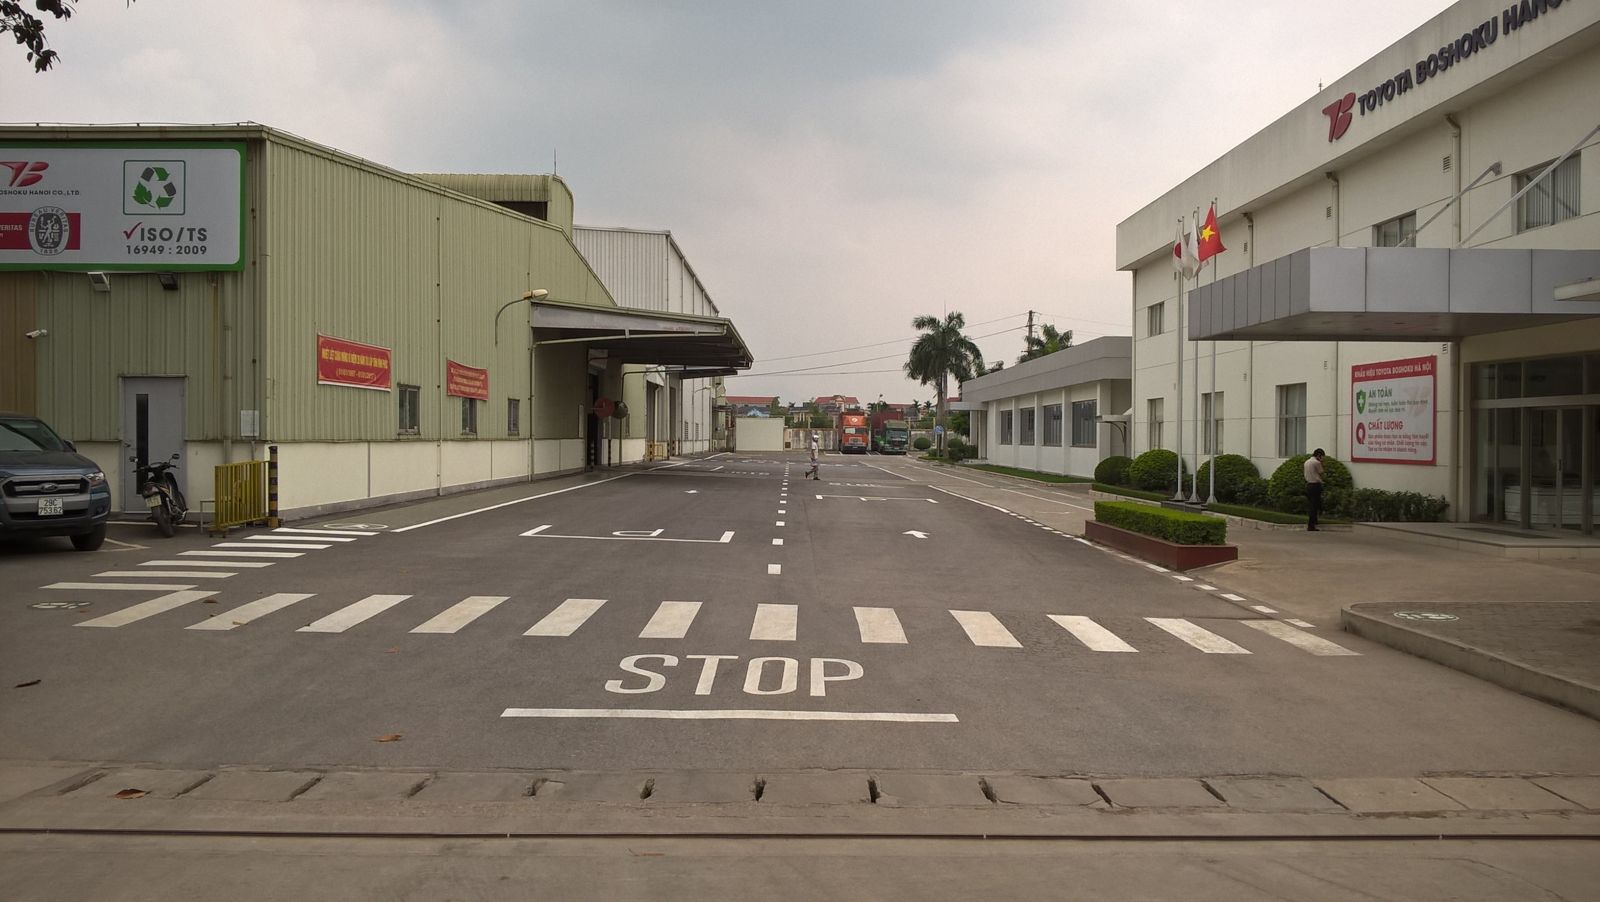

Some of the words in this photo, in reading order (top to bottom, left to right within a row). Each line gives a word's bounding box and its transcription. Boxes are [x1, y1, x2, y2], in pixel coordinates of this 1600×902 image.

[1357, 69, 1414, 116] TOYOTA
[1415, 16, 1499, 85] BOSHOKU
[1502, 0, 1570, 35] HAN
[1376, 367, 1391, 375] TOYOTA
[1392, 365, 1413, 374] BOSHOKU
[1368, 389, 1376, 398] AN
[604, 654, 864, 697] STOP
